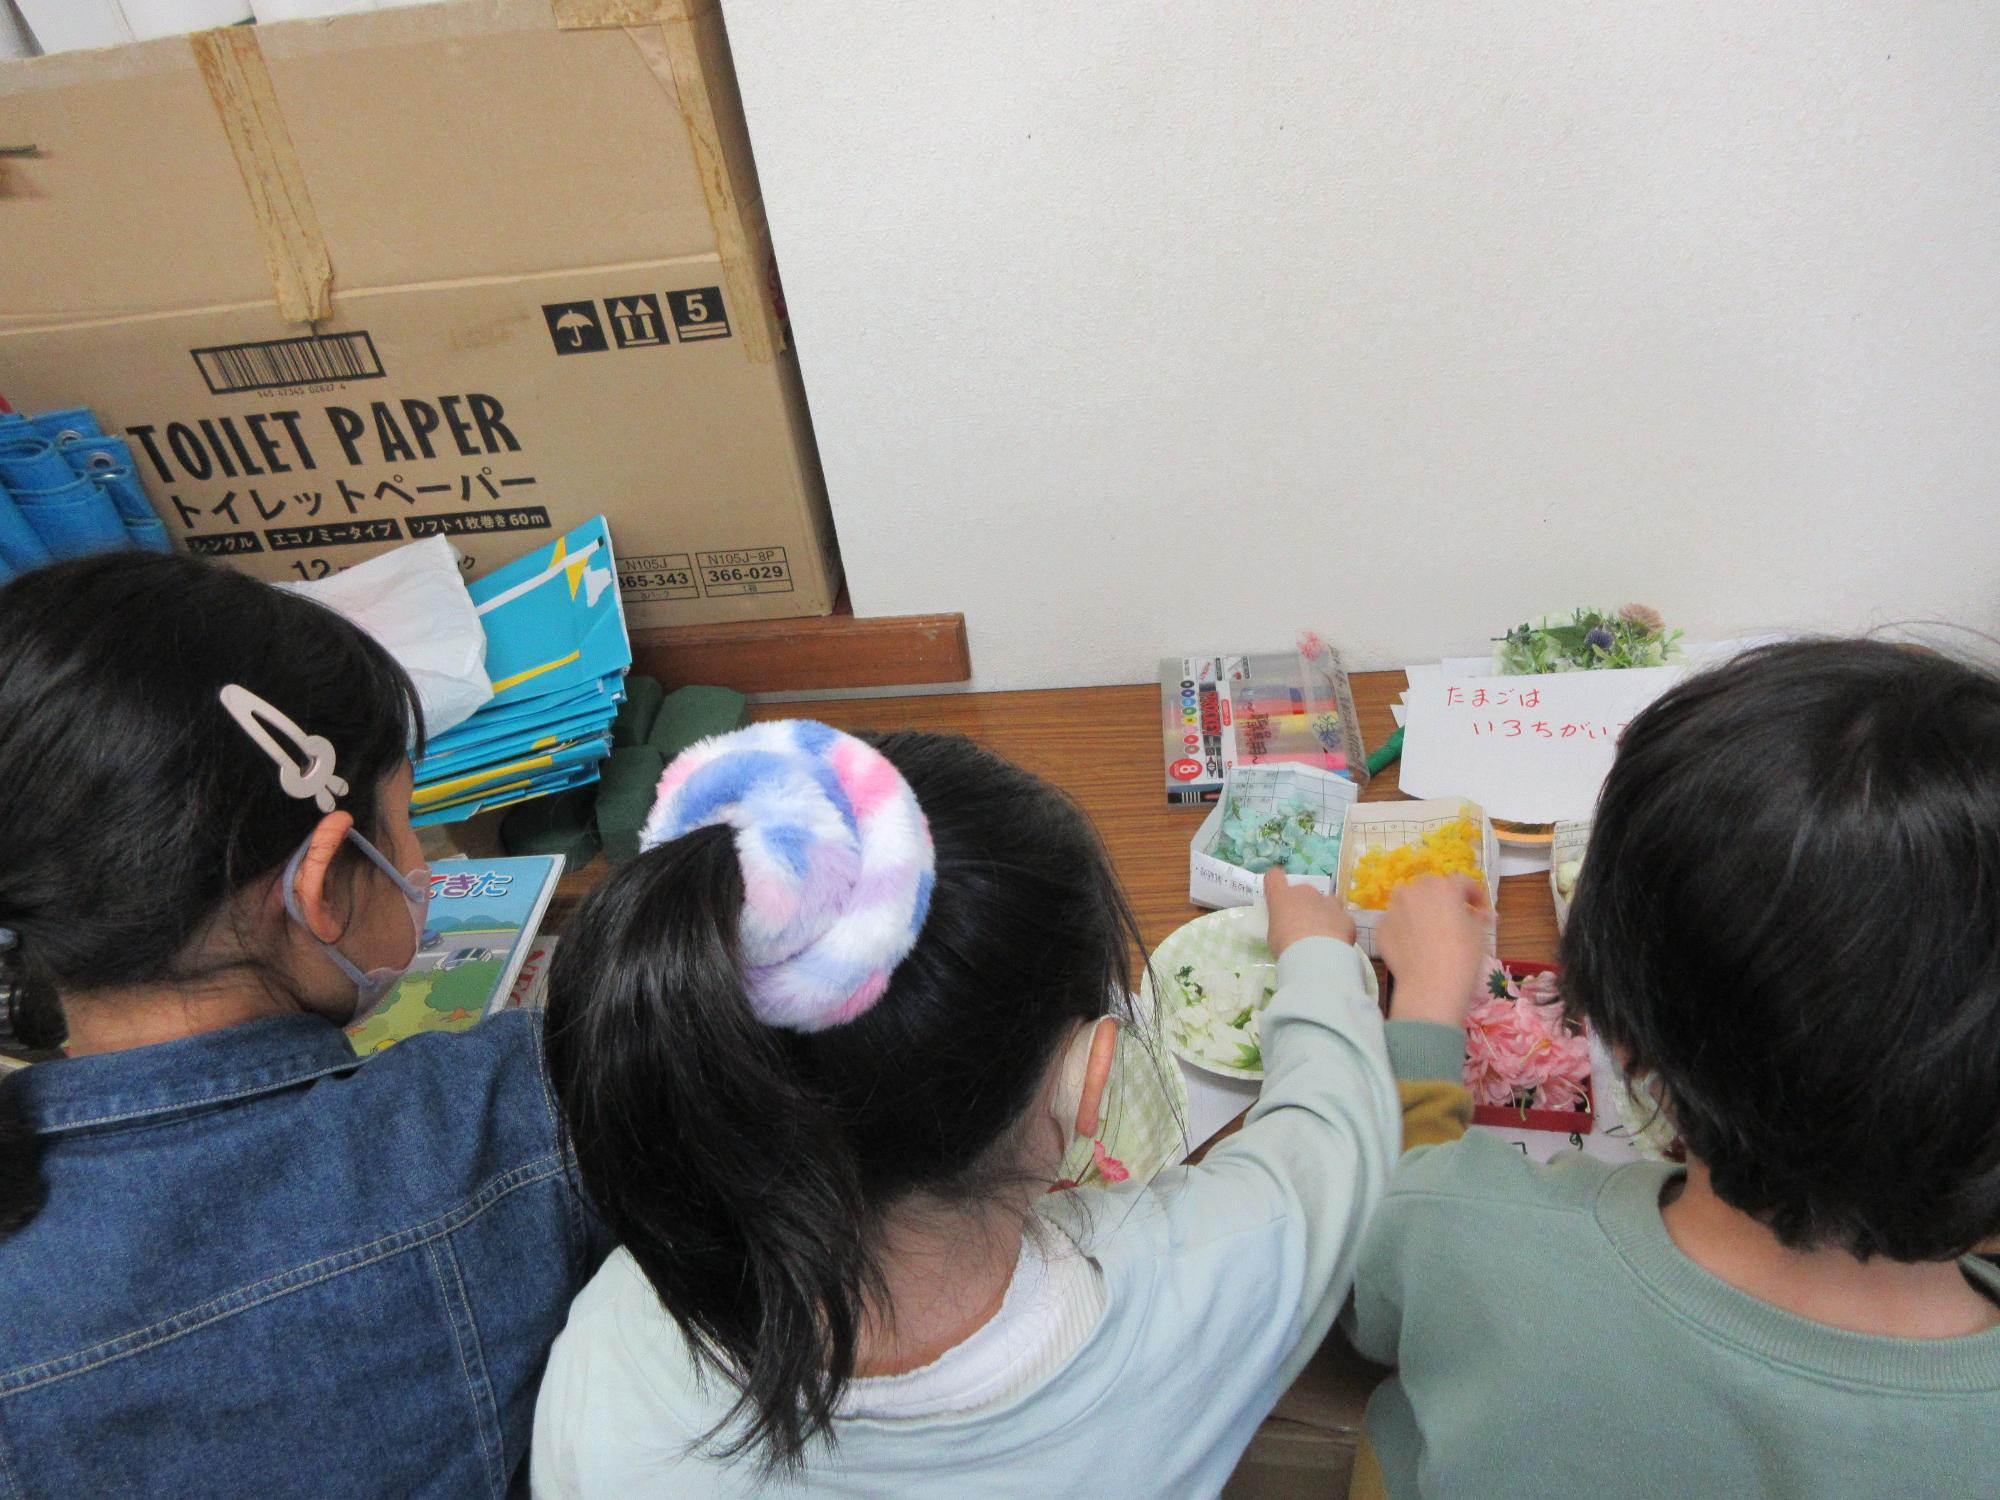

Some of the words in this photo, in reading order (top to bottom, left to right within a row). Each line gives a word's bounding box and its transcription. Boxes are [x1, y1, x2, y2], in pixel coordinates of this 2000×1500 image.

[686, 294, 709, 322] 5
[125, 411, 317, 483] TOILET
[325, 393, 522, 465] PAPER
[171, 466, 537, 529] トイレットペーパー
[273, 521, 393, 546] エコノミータイプ
[626, 558, 668, 571] N105J
[707, 551, 775, 565] N105J-8P
[708, 565, 784, 582] 366-029
[1447, 687, 1541, 708] たまごは
